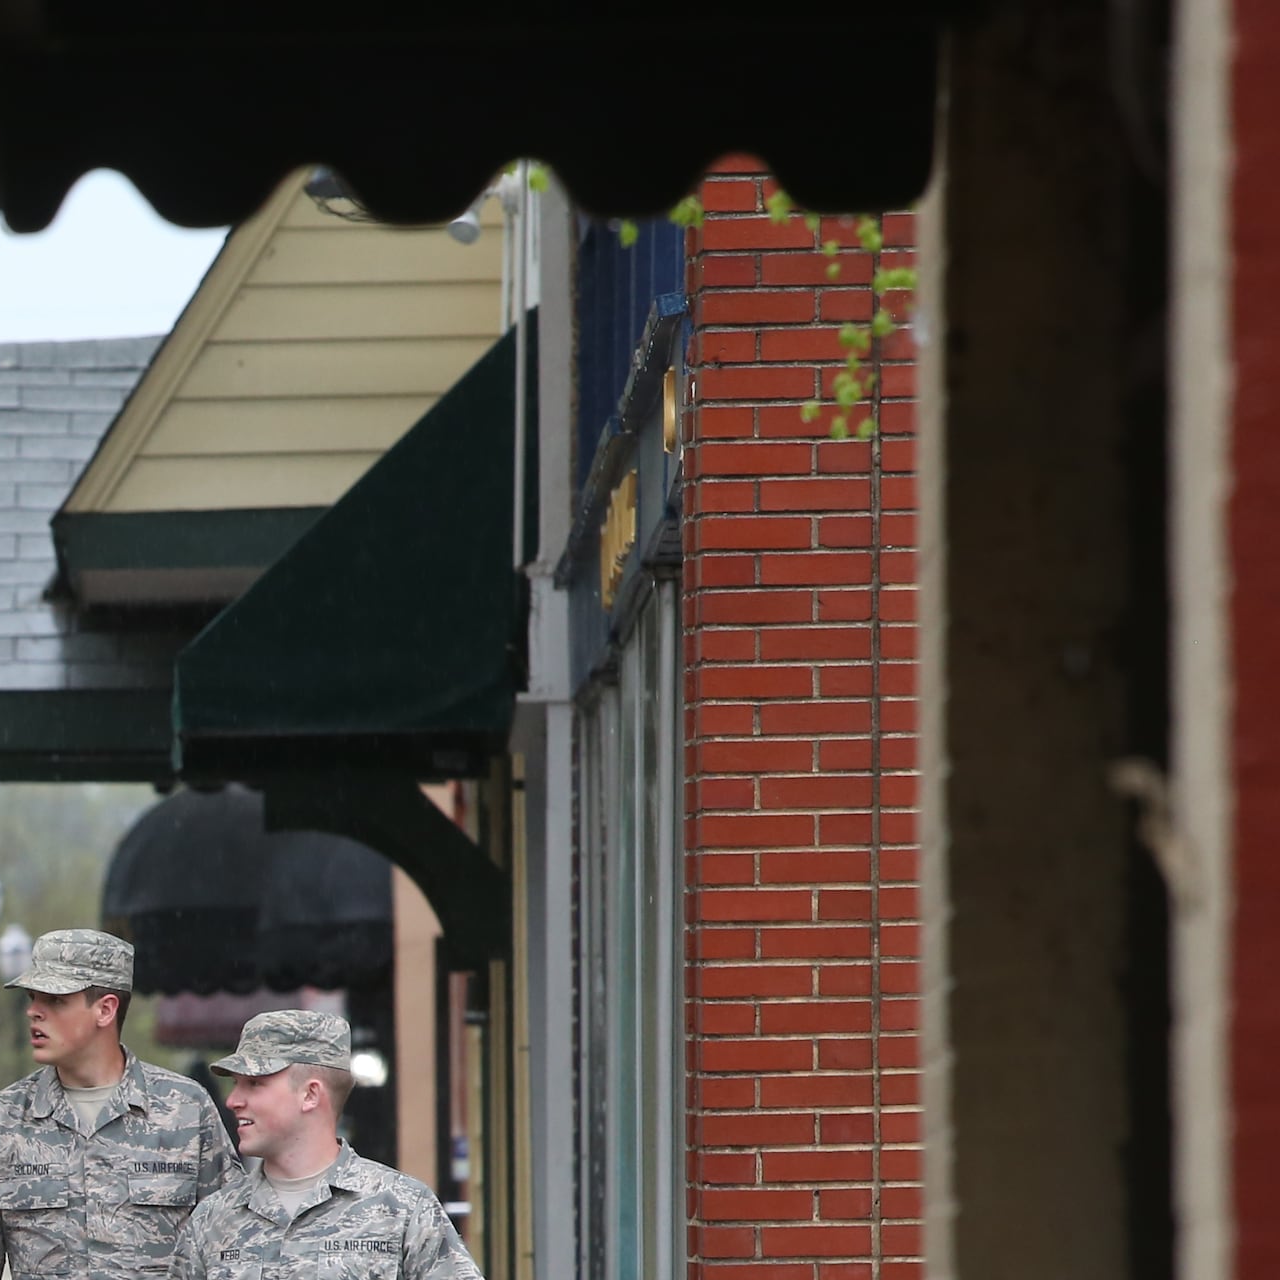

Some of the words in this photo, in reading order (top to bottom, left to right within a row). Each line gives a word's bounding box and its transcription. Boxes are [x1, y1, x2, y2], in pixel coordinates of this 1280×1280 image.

[15, 1164, 49, 1176] SOLOMON
[324, 1240, 342, 1252] U.S.
[343, 1240, 360, 1252] AIR
[360, 1240, 398, 1254] FORCE
[220, 1249, 240, 1261] WEBB
